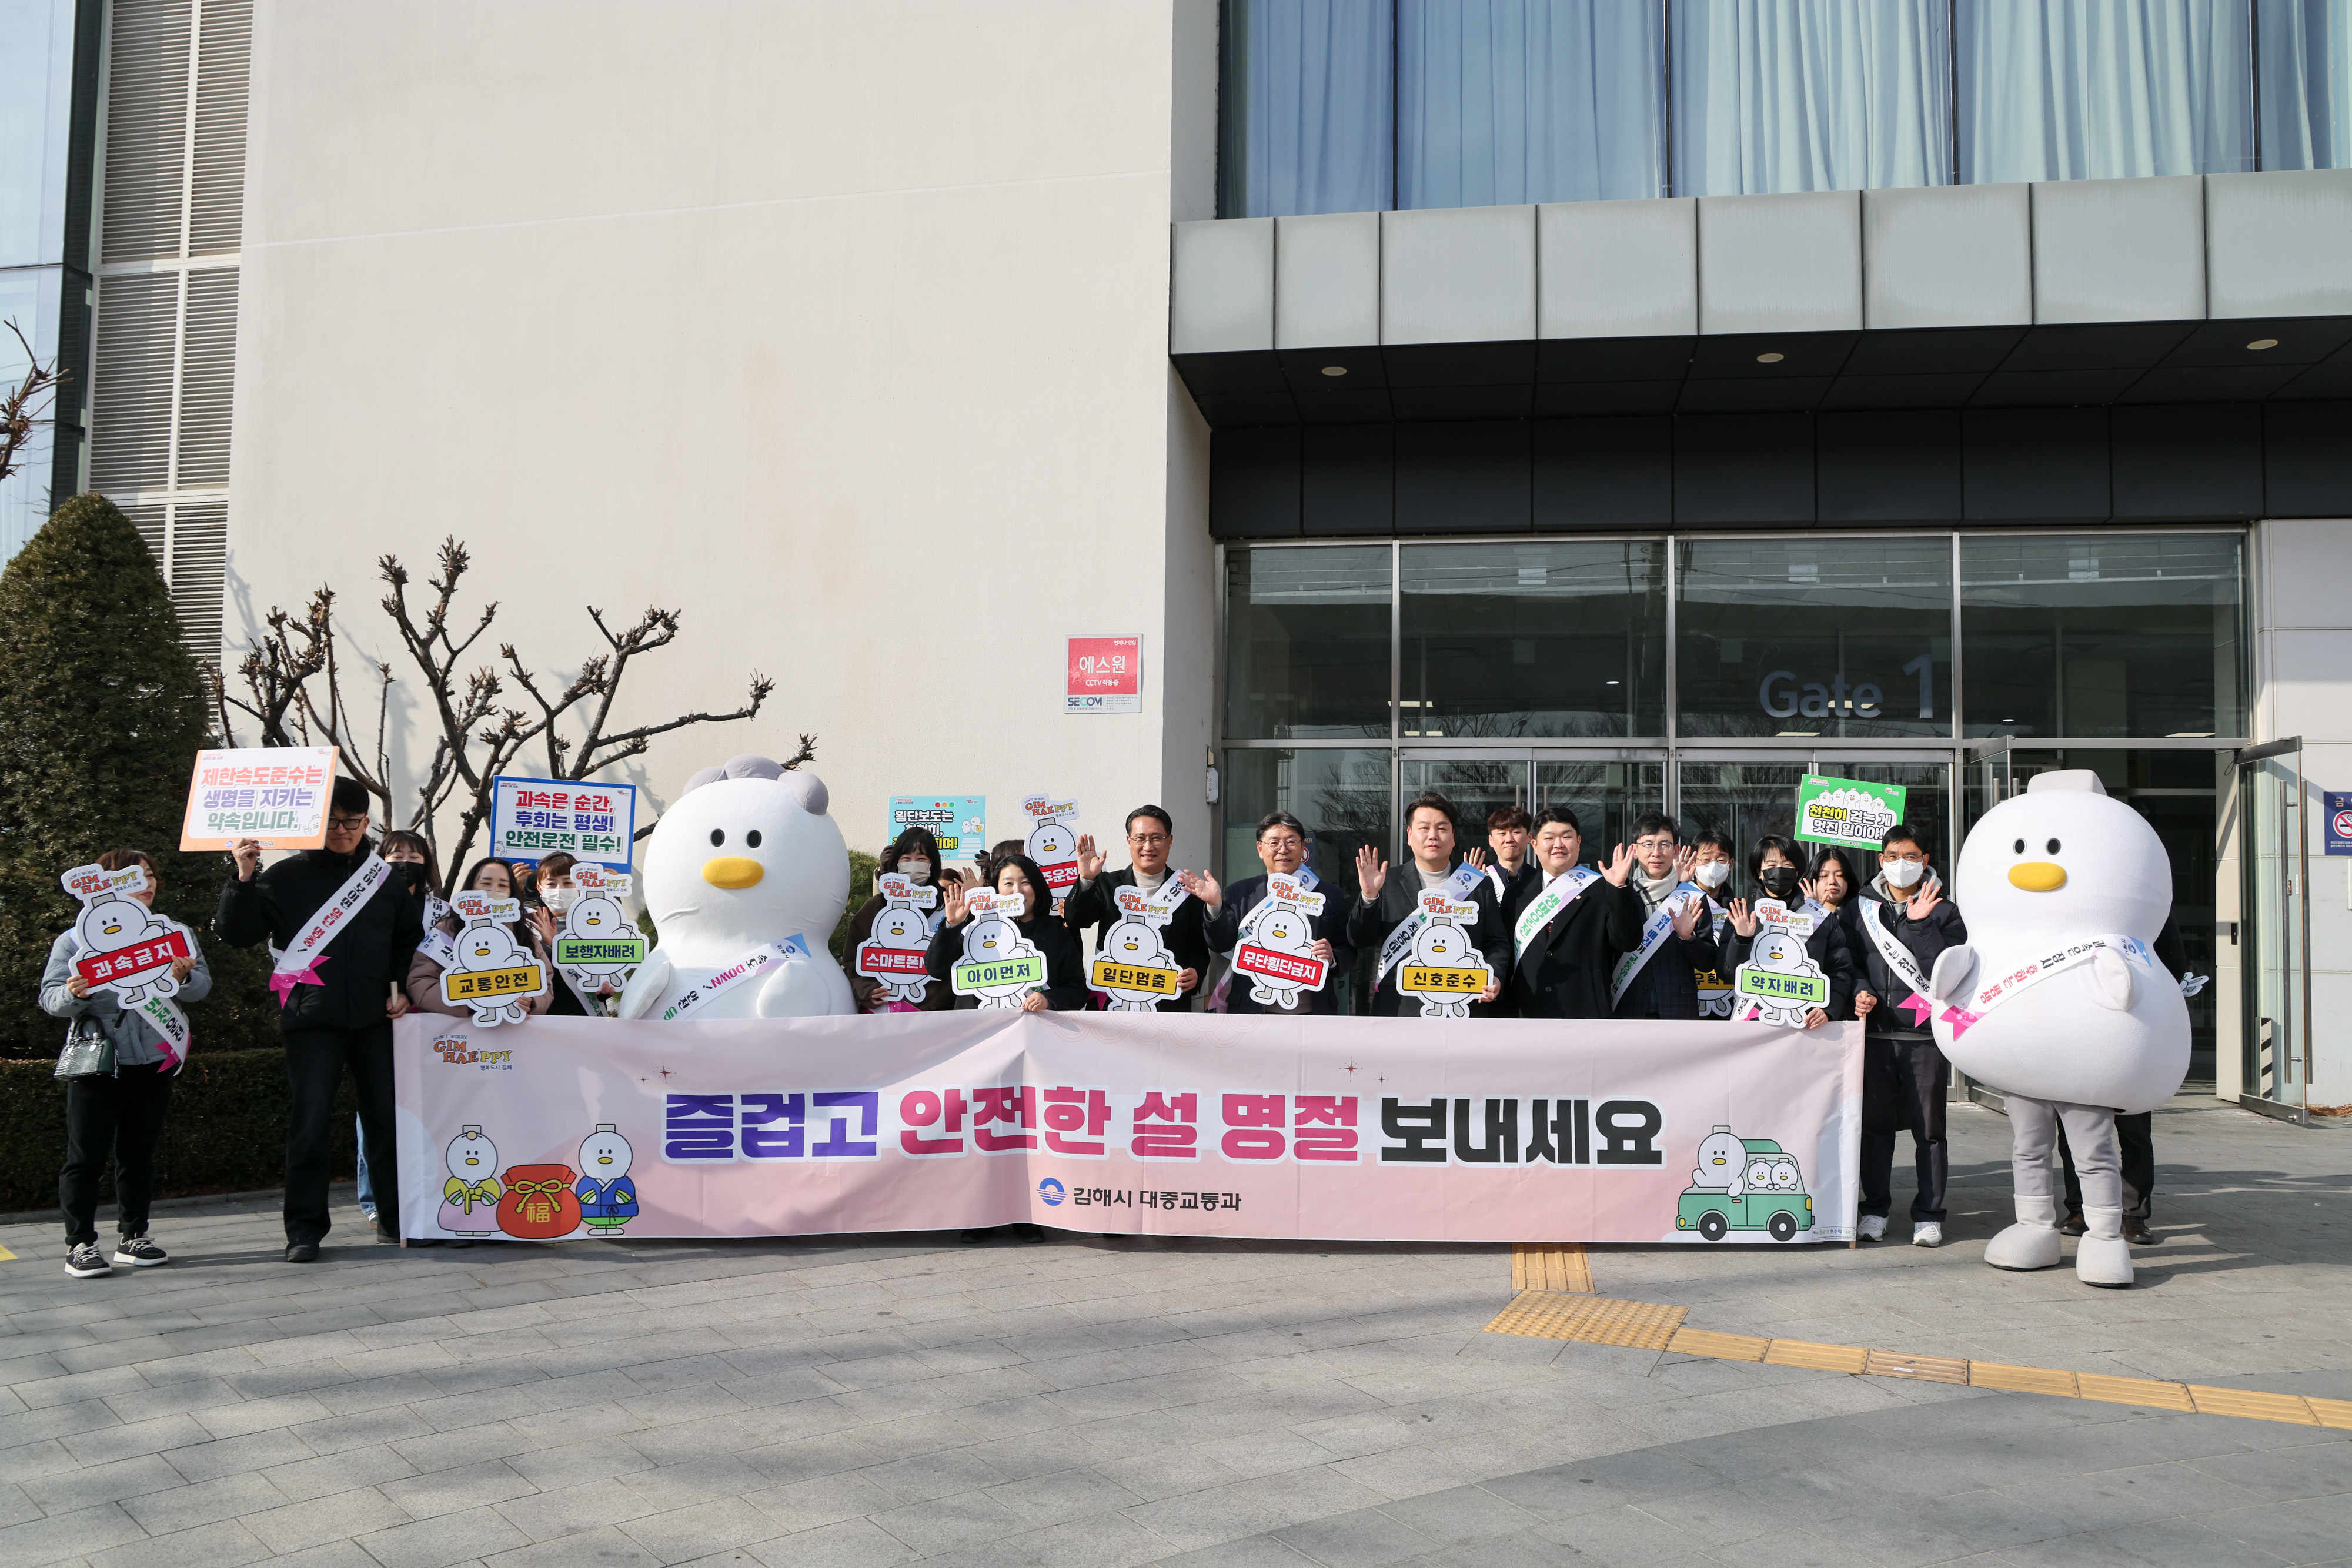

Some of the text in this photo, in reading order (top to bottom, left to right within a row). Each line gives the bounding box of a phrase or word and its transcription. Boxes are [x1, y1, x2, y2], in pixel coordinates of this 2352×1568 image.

[1079, 656, 1126, 674] 에스원
[1760, 653, 1933, 718] Gate 1
[1068, 697, 1102, 706] SECOM
[201, 765, 323, 787] 제한속도준수는
[203, 788, 313, 808] 생명을 지키는
[515, 790, 613, 813] 과속은 순간,
[1025, 801, 1046, 811] GIM
[207, 810, 298, 831] 약속입니다.
[515, 810, 614, 833] 후회는 평생!
[895, 810, 954, 823] 횡단보도는
[1809, 804, 1892, 827] 천천히 걷는 게
[1813, 819, 1884, 840] 멋진 일이야!
[506, 830, 622, 852] 안전운전 필수!
[71, 874, 100, 889] GIM
[362, 862, 382, 886] 사람이
[576, 871, 599, 880] GIM
[1456, 875, 1470, 891] 김해시
[1568, 874, 1583, 887] 김해시
[884, 881, 905, 890] GIM
[1272, 881, 1294, 893] GIM
[340, 882, 366, 910] 보이면
[457, 900, 482, 910] GIM
[1119, 894, 1141, 904] GIM
[1423, 897, 1445, 906] GIM
[322, 907, 343, 928] 일단
[1519, 893, 1562, 938] 생명운전
[1760, 906, 1781, 916] GIM
[1809, 903, 1824, 916] 김해시
[566, 945, 635, 958] 보행자배려
[777, 944, 790, 959] 김해시
[2120, 938, 2130, 955] 김해시
[92, 941, 174, 979] 과속금지
[746, 954, 768, 969] 속도
[1242, 951, 1317, 980] 무단횡단금지
[1883, 941, 1900, 959] 차는
[1897, 957, 1917, 977] 잠시
[967, 963, 1030, 983] 아이먼저
[1103, 968, 1166, 988] 일단멈춤
[1413, 972, 1476, 988] 신호준수
[1980, 940, 2107, 1004] 과속은 잠시 후회는 평생
[459, 972, 529, 994] 교통안전
[1751, 975, 1813, 996] 약자배려
[677, 990, 699, 1010] 안전
[663, 1006, 678, 1020] UP
[433, 1039, 467, 1053] GIM
[665, 1086, 1663, 1165] 즐겁고 안전한 설 명절 보내세요
[1074, 1187, 1242, 1211] 김해시 대중교통과
[526, 1202, 551, 1223] 福
